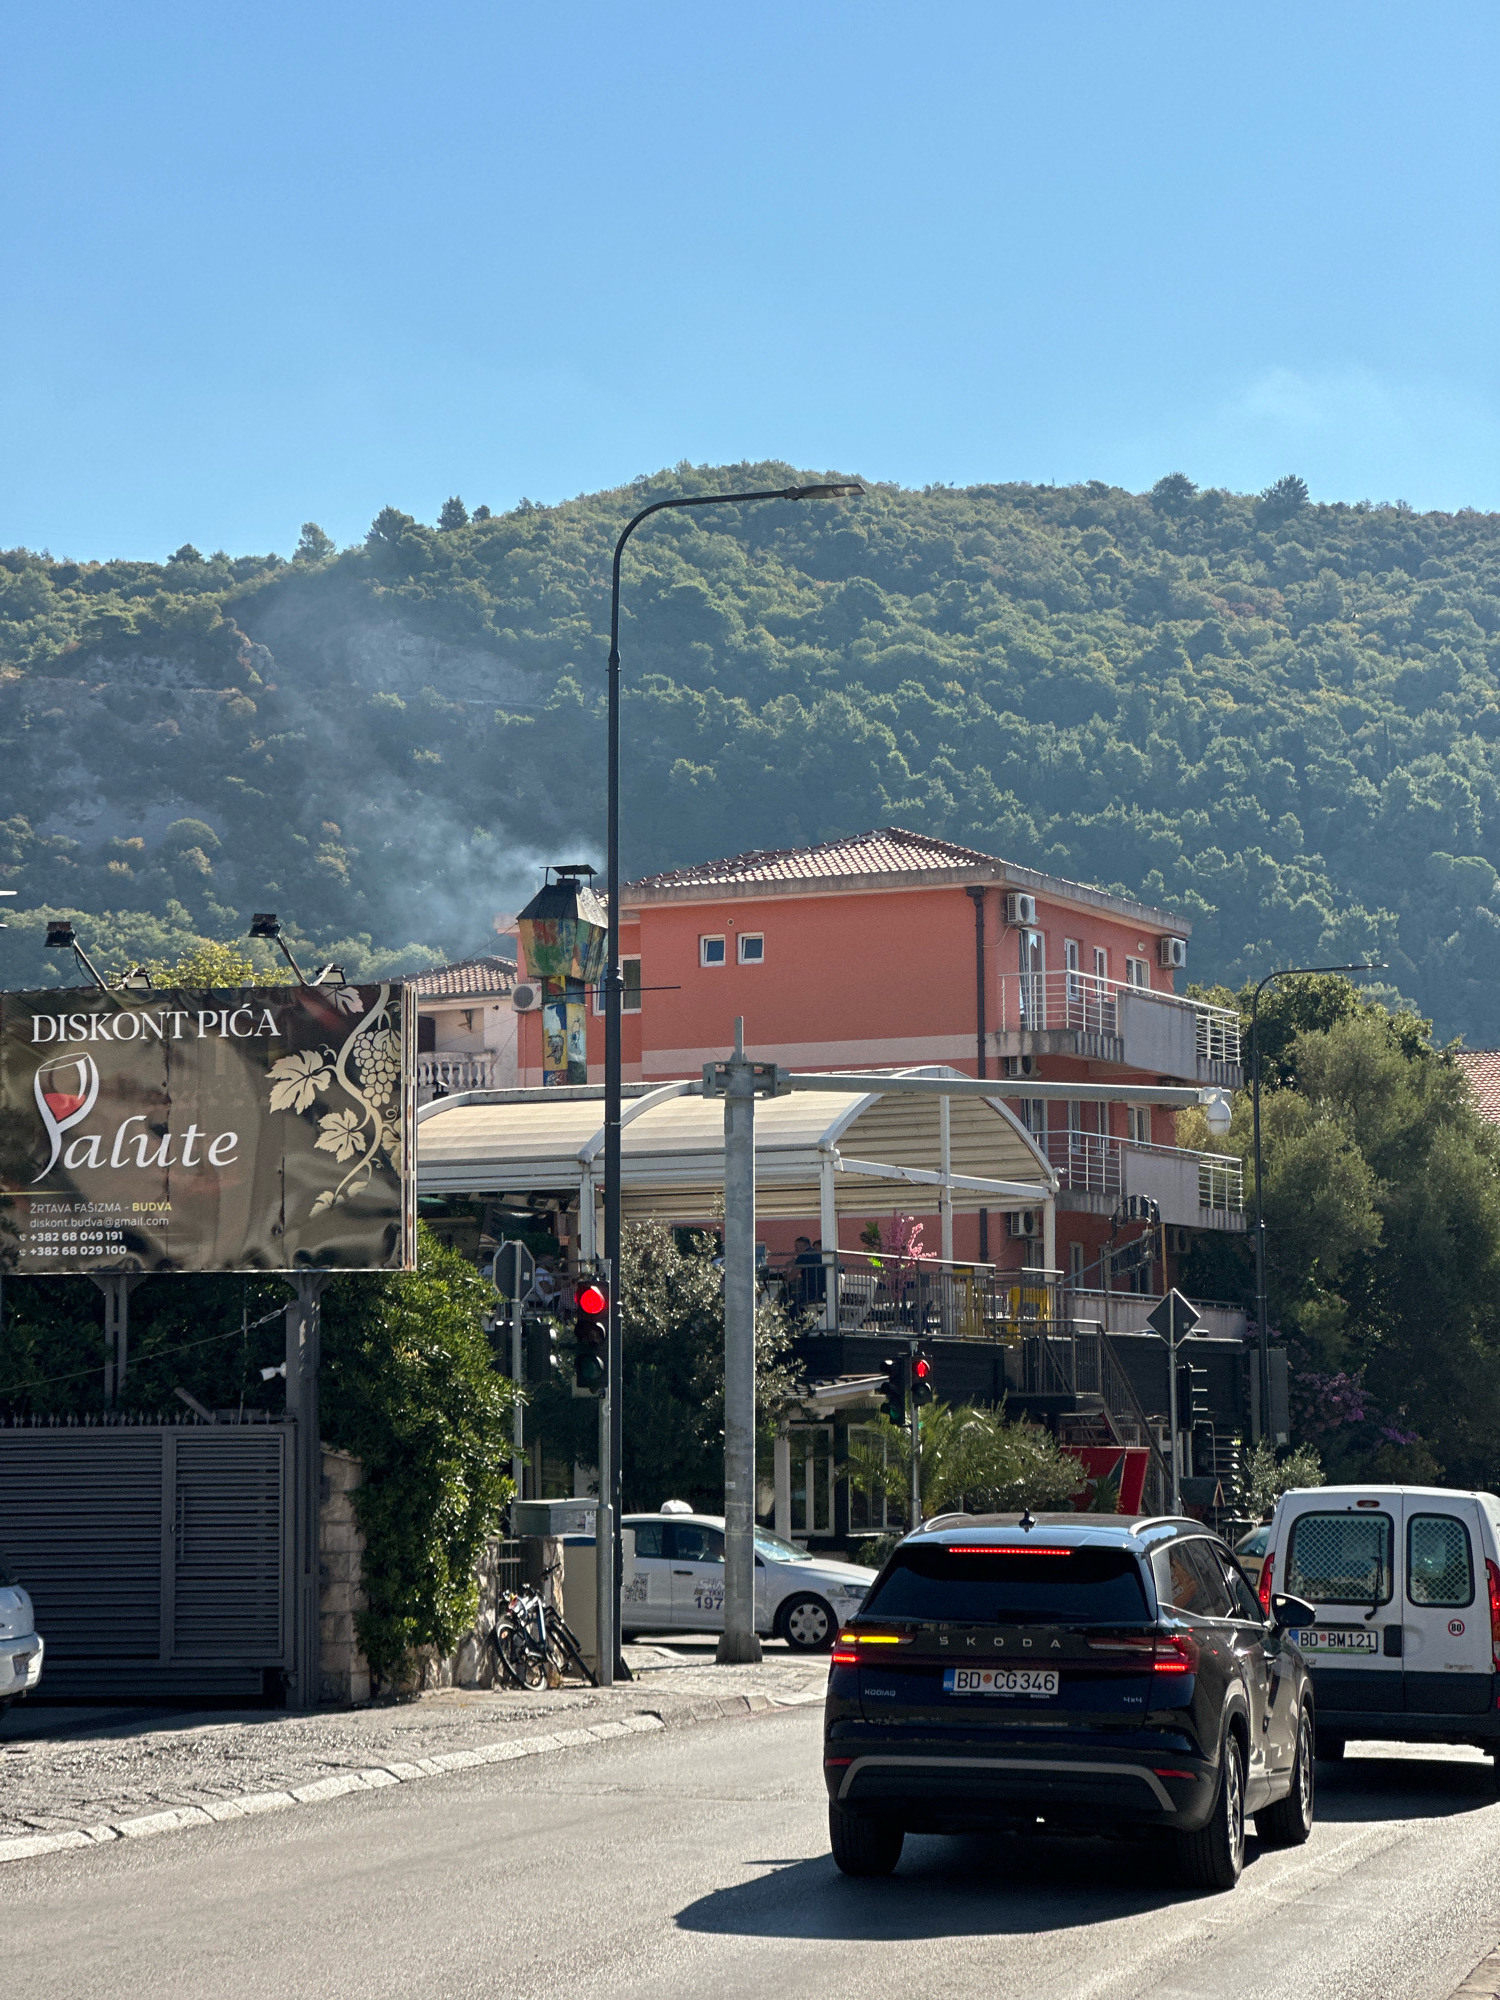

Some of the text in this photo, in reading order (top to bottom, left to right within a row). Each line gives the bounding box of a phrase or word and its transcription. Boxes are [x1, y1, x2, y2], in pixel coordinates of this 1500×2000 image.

[31, 1003, 282, 1043] DISKONT PIĆA
[30, 1202, 71, 1214] ŽRTAVA
[74, 1201, 122, 1213] FAŠIZMA
[132, 1202, 172, 1212] BUDVA
[30, 1216, 169, 1228] diskont.budva@gmail.com
[30, 1231, 123, 1242] +382 68 049 191
[30, 1245, 127, 1256] +382 68 029 100
[695, 1596, 723, 1610] 197
[1451, 1623, 1462, 1633] 80
[1300, 1632, 1375, 1648] BD BM121
[956, 1671, 1055, 1691] BD CG346
